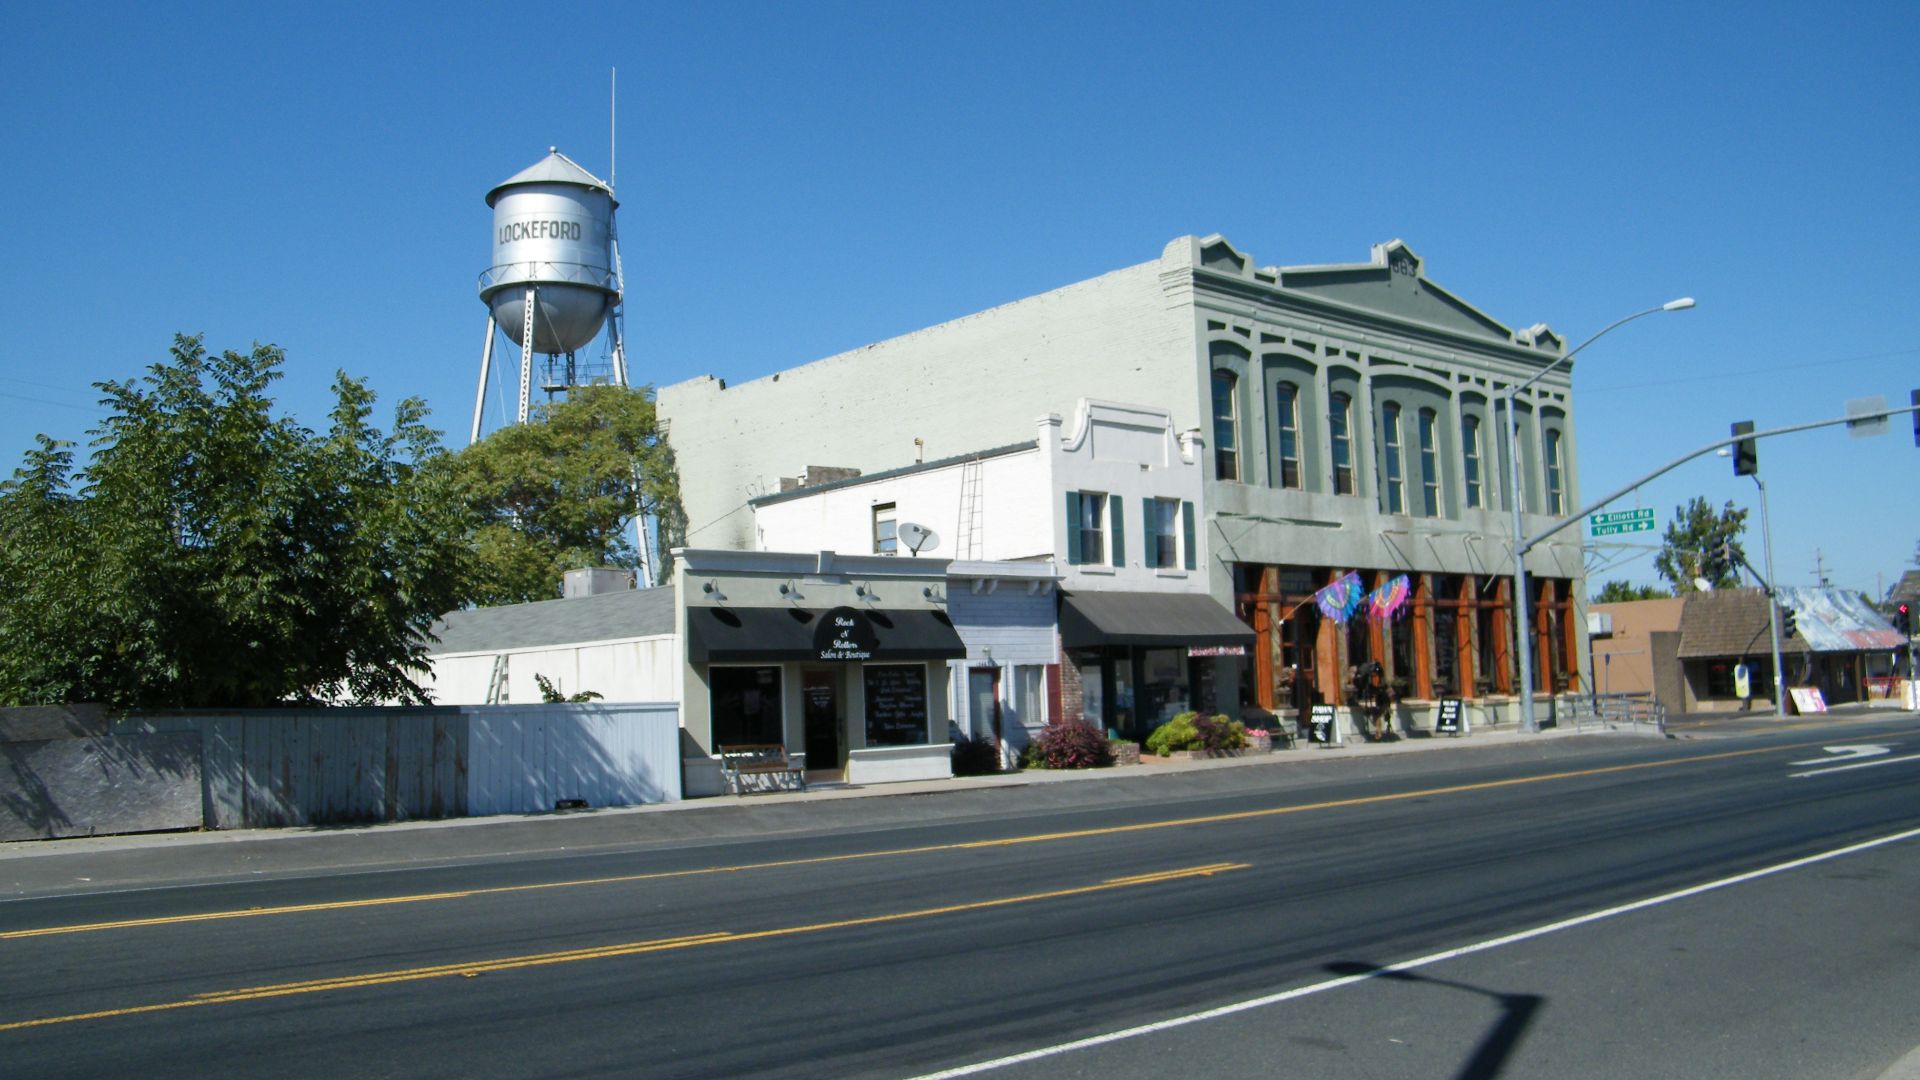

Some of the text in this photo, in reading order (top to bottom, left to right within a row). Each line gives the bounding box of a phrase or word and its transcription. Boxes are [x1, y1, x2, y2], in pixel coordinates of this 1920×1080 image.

[499, 220, 581, 245] LOCKEFORD
[1607, 510, 1649, 522] Elliott Rd
[1597, 524, 1634, 536] Tully Rd
[835, 616, 855, 627] Rock
[820, 648, 871, 661] Salon & Boutique
[1312, 705, 1333, 714] PAWN
[1310, 714, 1333, 724] SHOP
